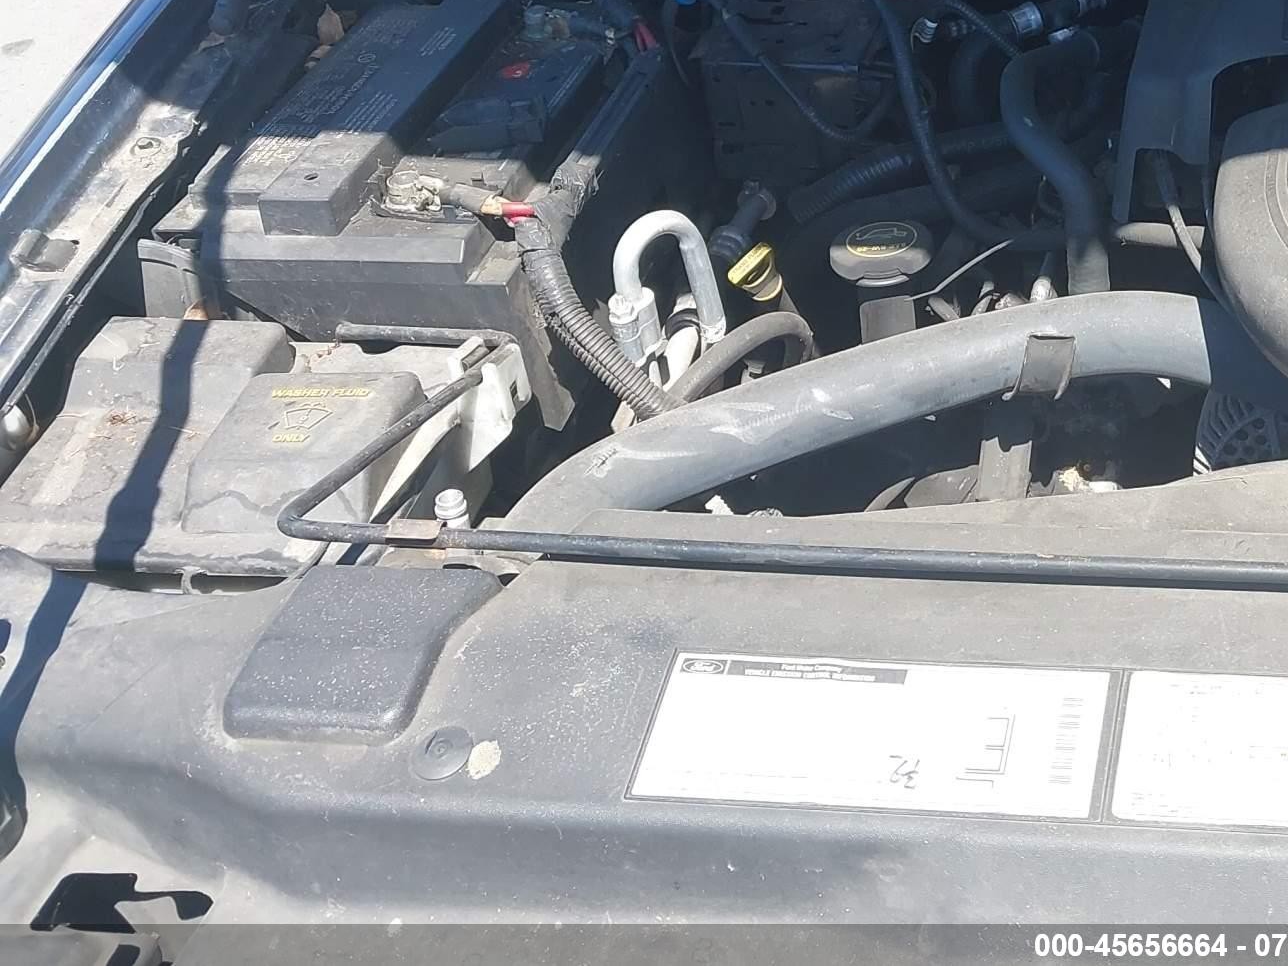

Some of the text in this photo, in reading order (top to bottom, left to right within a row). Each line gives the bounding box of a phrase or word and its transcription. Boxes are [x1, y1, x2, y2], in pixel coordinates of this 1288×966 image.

[271, 388, 369, 398] WASHER FLUID
[272, 434, 310, 442] ONLY
